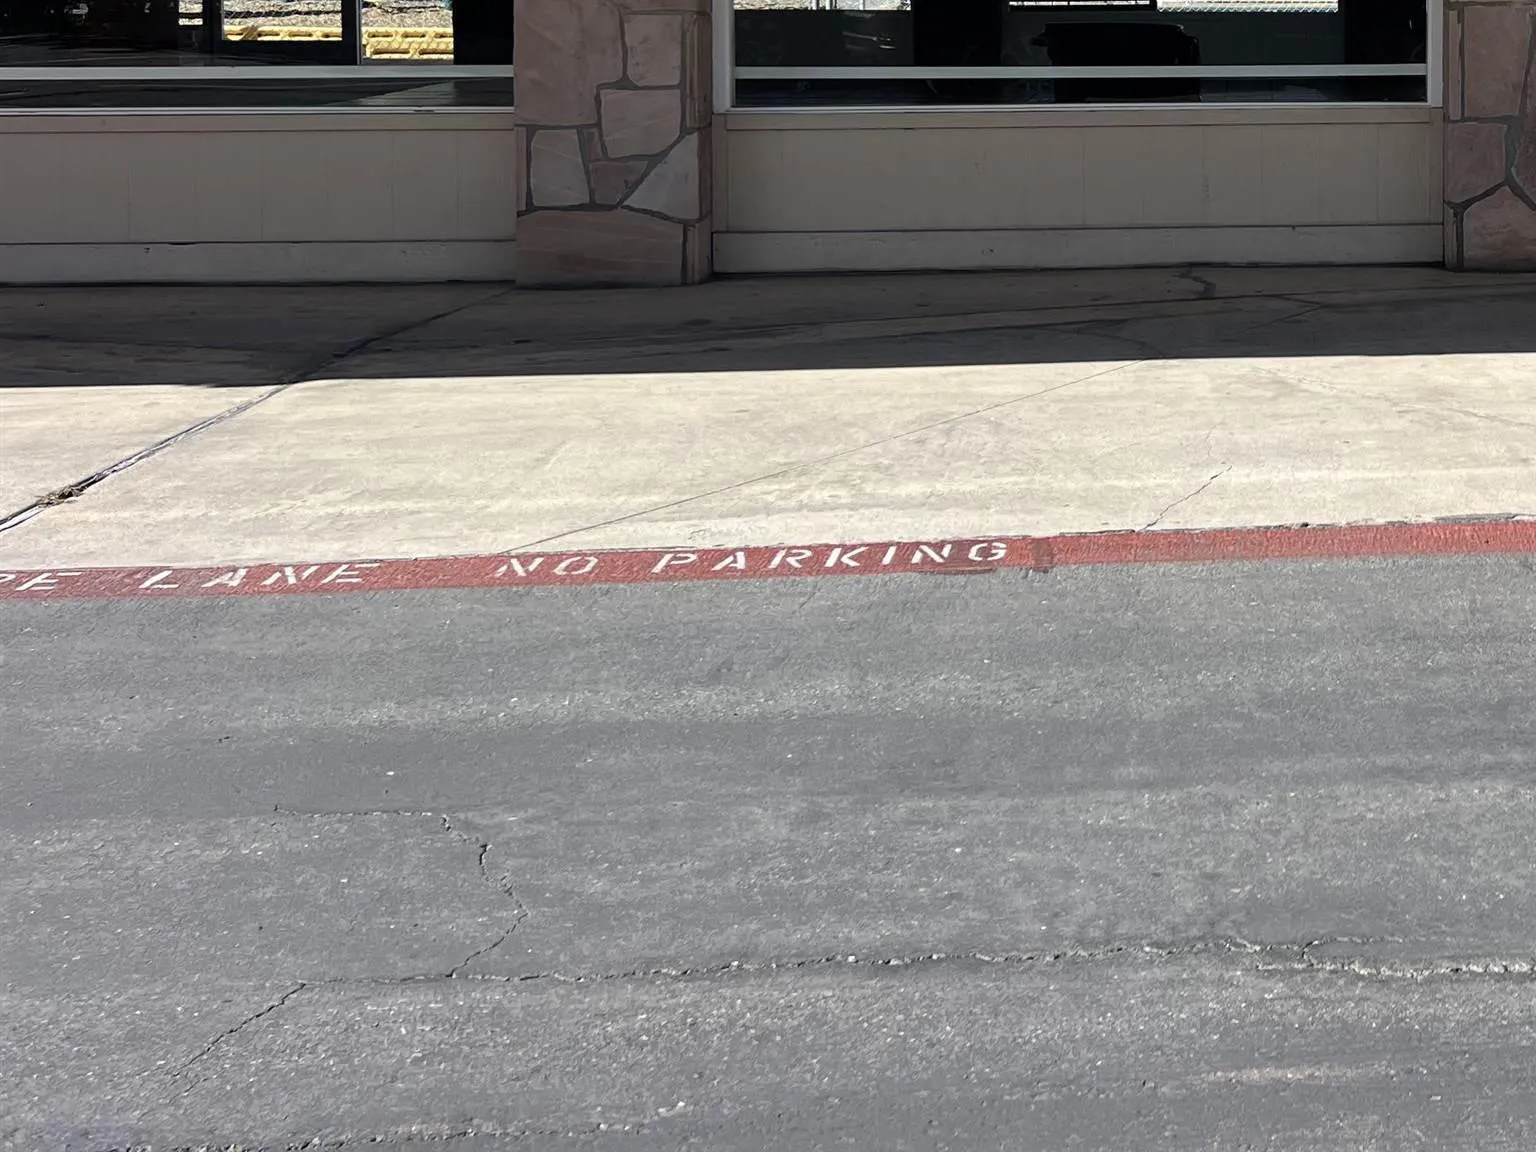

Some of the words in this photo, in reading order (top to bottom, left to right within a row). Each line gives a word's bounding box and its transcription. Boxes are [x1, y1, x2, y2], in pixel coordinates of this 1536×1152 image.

[138, 562, 381, 589] LANE
[495, 556, 599, 577] NO
[650, 542, 1008, 574] PARKING
